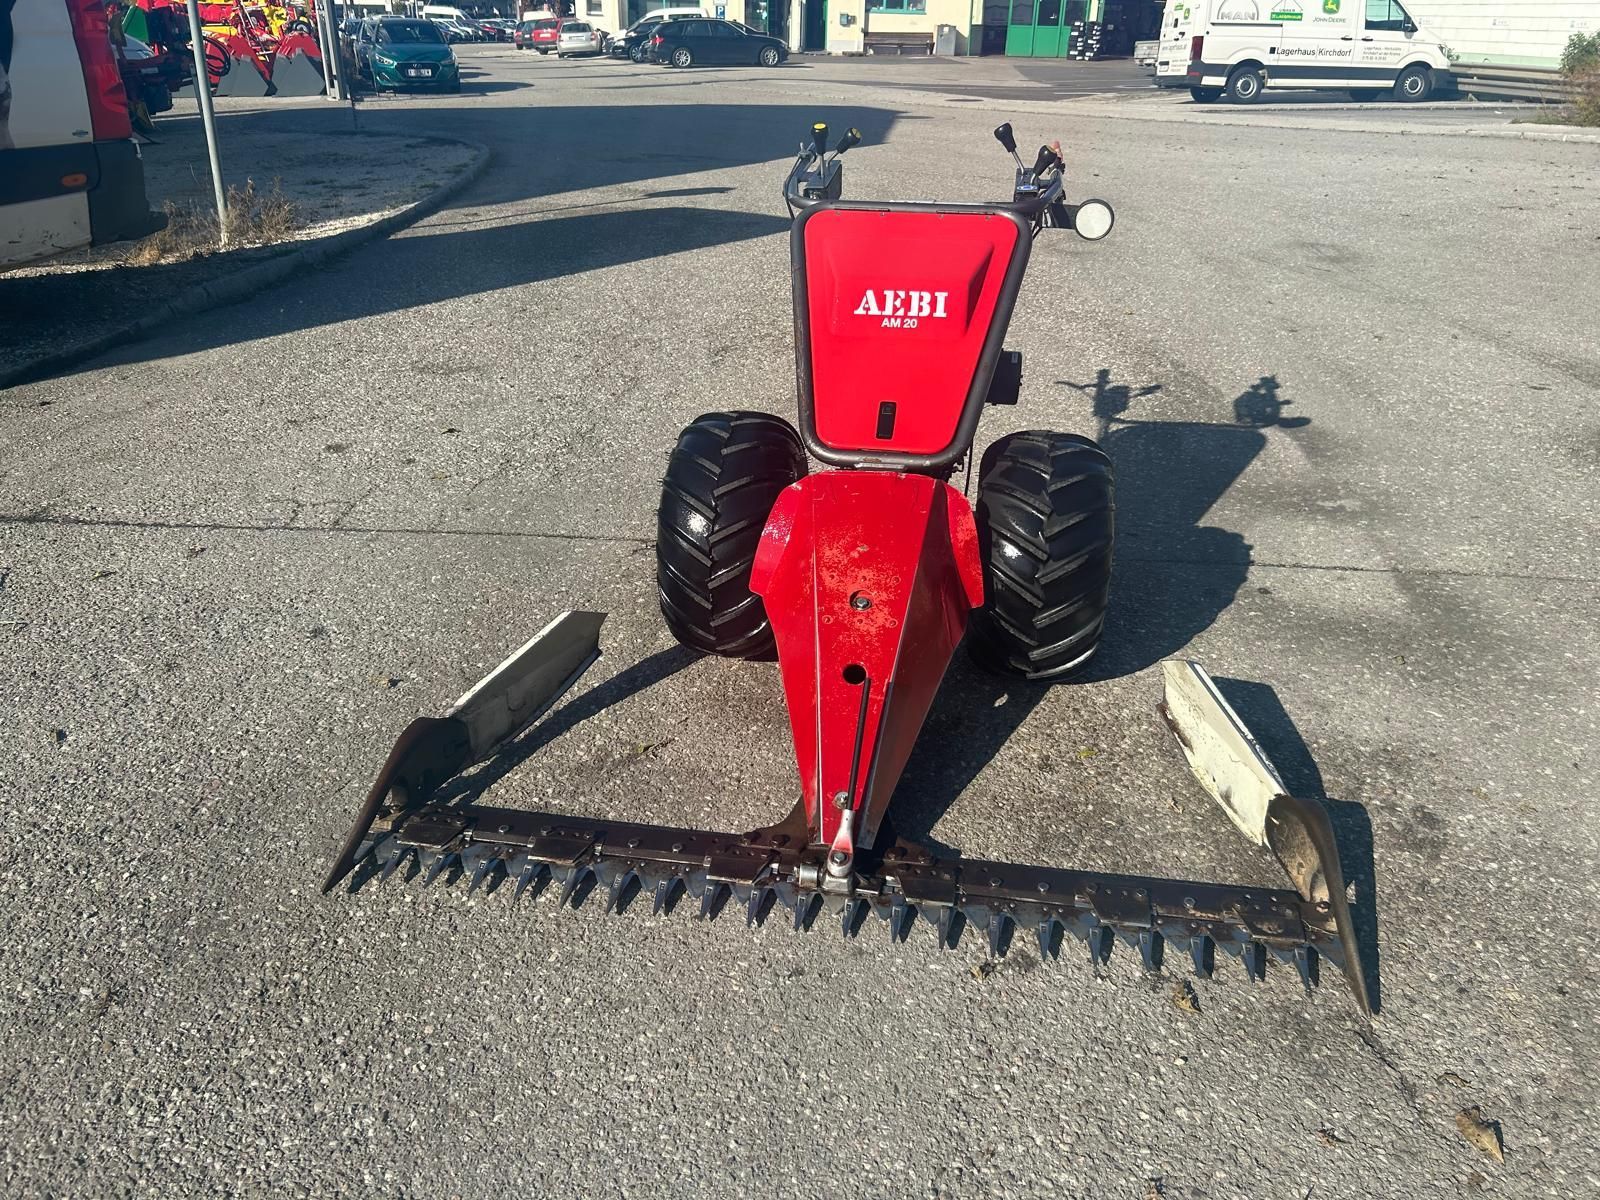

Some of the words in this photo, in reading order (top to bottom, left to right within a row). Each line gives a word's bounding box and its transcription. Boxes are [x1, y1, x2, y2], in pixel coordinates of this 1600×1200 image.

[718, 6, 724, 16] P
[1221, 12, 1256, 20] MAN
[1276, 47, 1316, 56] Lagerhaus
[1318, 48, 1352, 57] Kirchdorf
[853, 289, 949, 318] AEBI
[881, 317, 901, 328] AM
[902, 318, 918, 329] 20
